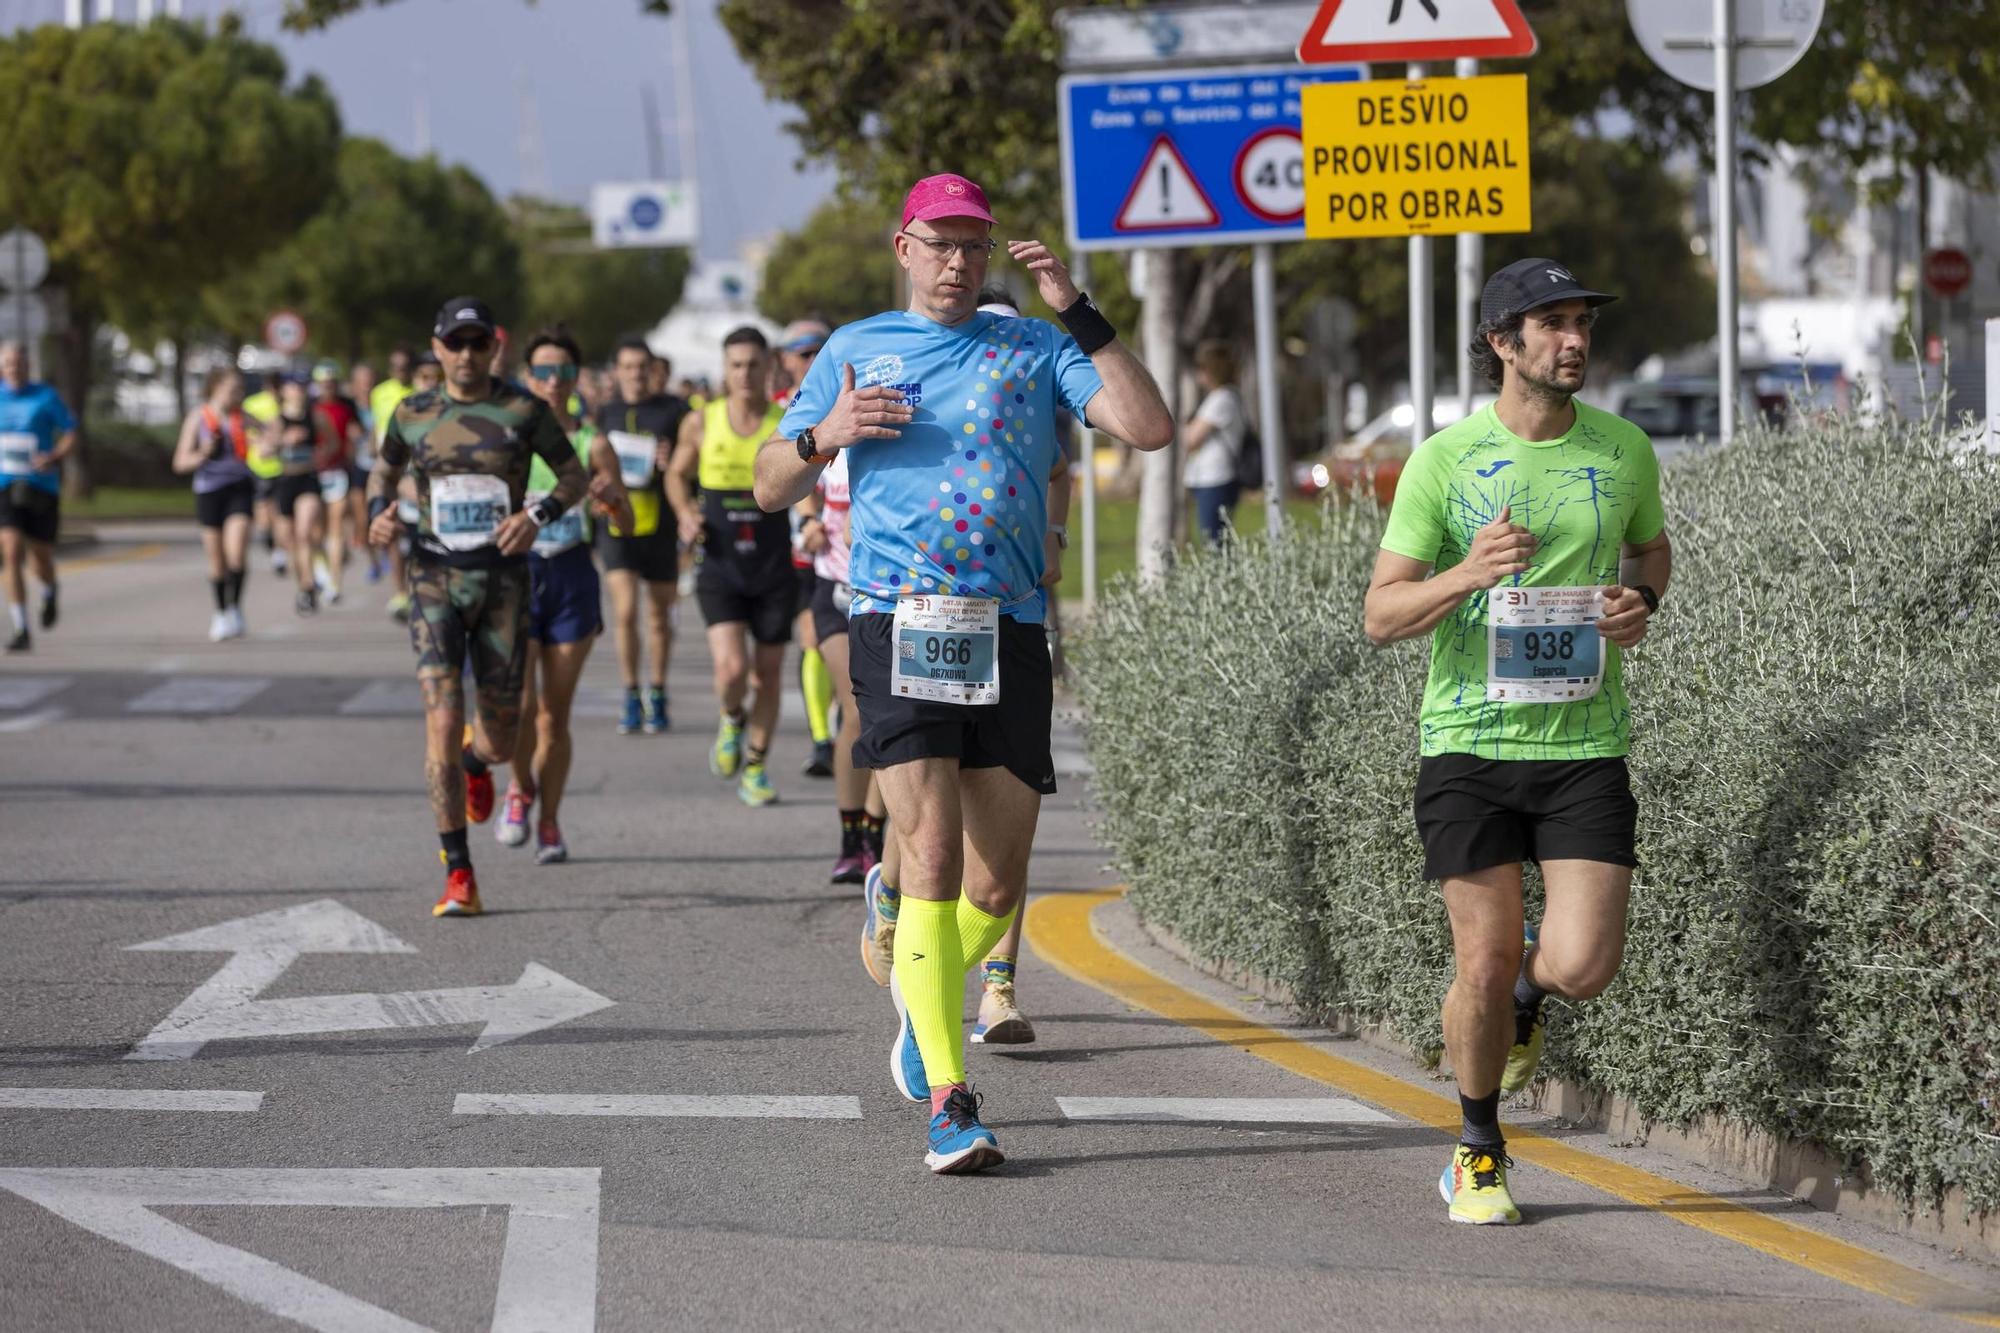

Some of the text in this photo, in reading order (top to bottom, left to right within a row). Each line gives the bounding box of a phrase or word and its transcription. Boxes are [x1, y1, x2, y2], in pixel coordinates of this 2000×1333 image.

[1358, 92, 1469, 127] DESVIO
[1313, 138, 1518, 176] PROVISIONAL
[1329, 186, 1504, 223] POR OBRAS
[913, 598, 931, 612] 31
[1507, 591, 1529, 606] 31
[925, 636, 972, 665] 966
[1524, 630, 1574, 661] 938
